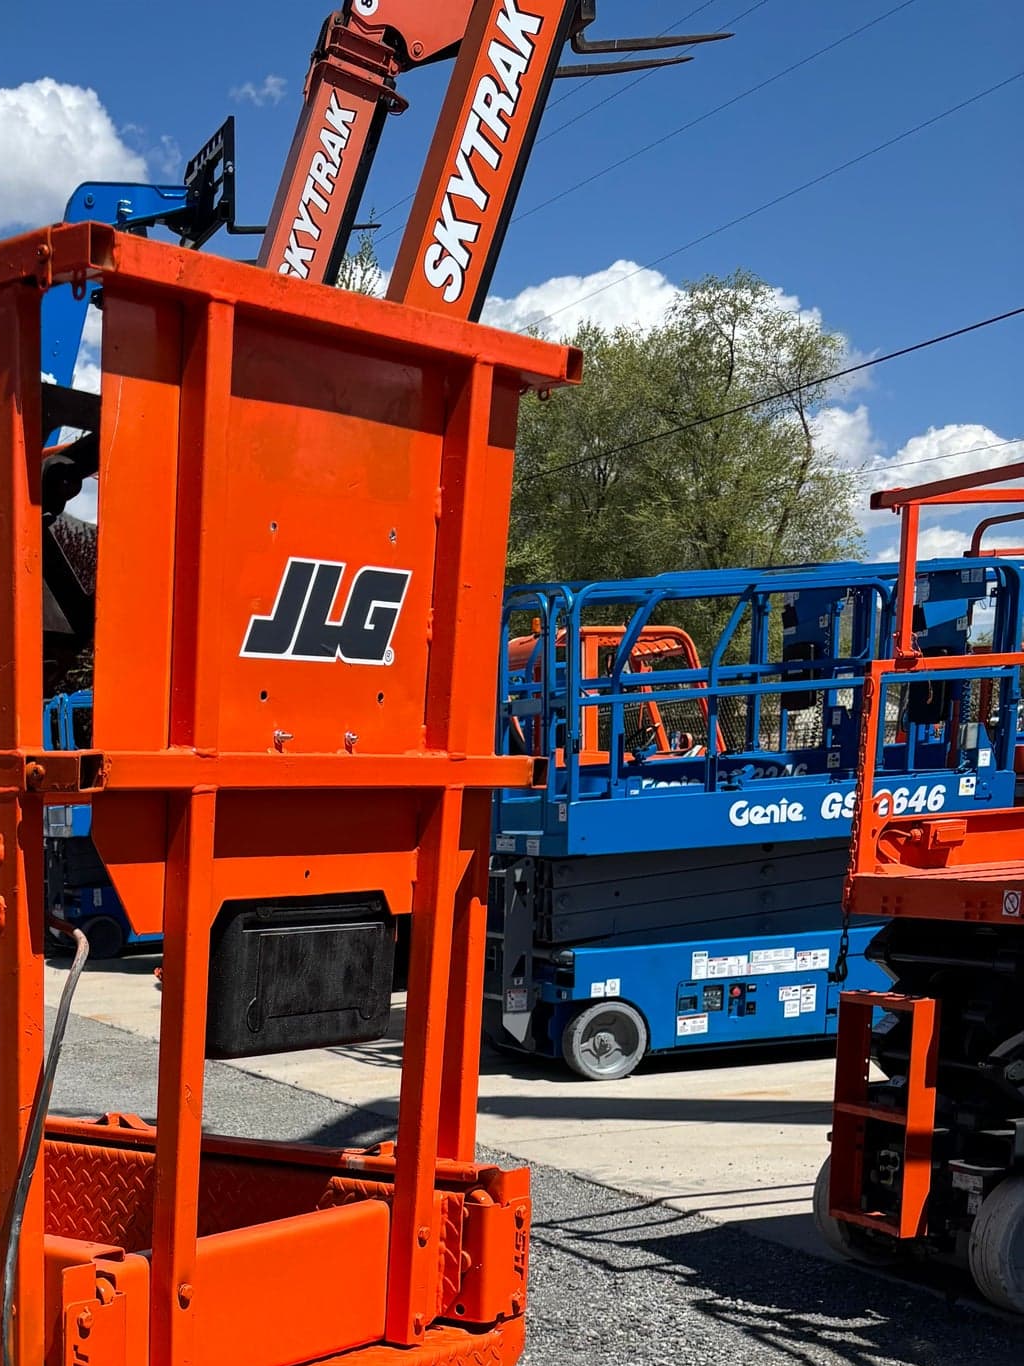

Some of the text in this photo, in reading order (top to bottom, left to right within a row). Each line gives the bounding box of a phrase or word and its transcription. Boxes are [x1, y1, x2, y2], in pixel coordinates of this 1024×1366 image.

[425, 0, 542, 303] SKYTRAK
[240, 557, 412, 665] JLG
[729, 798, 804, 827] Genie
